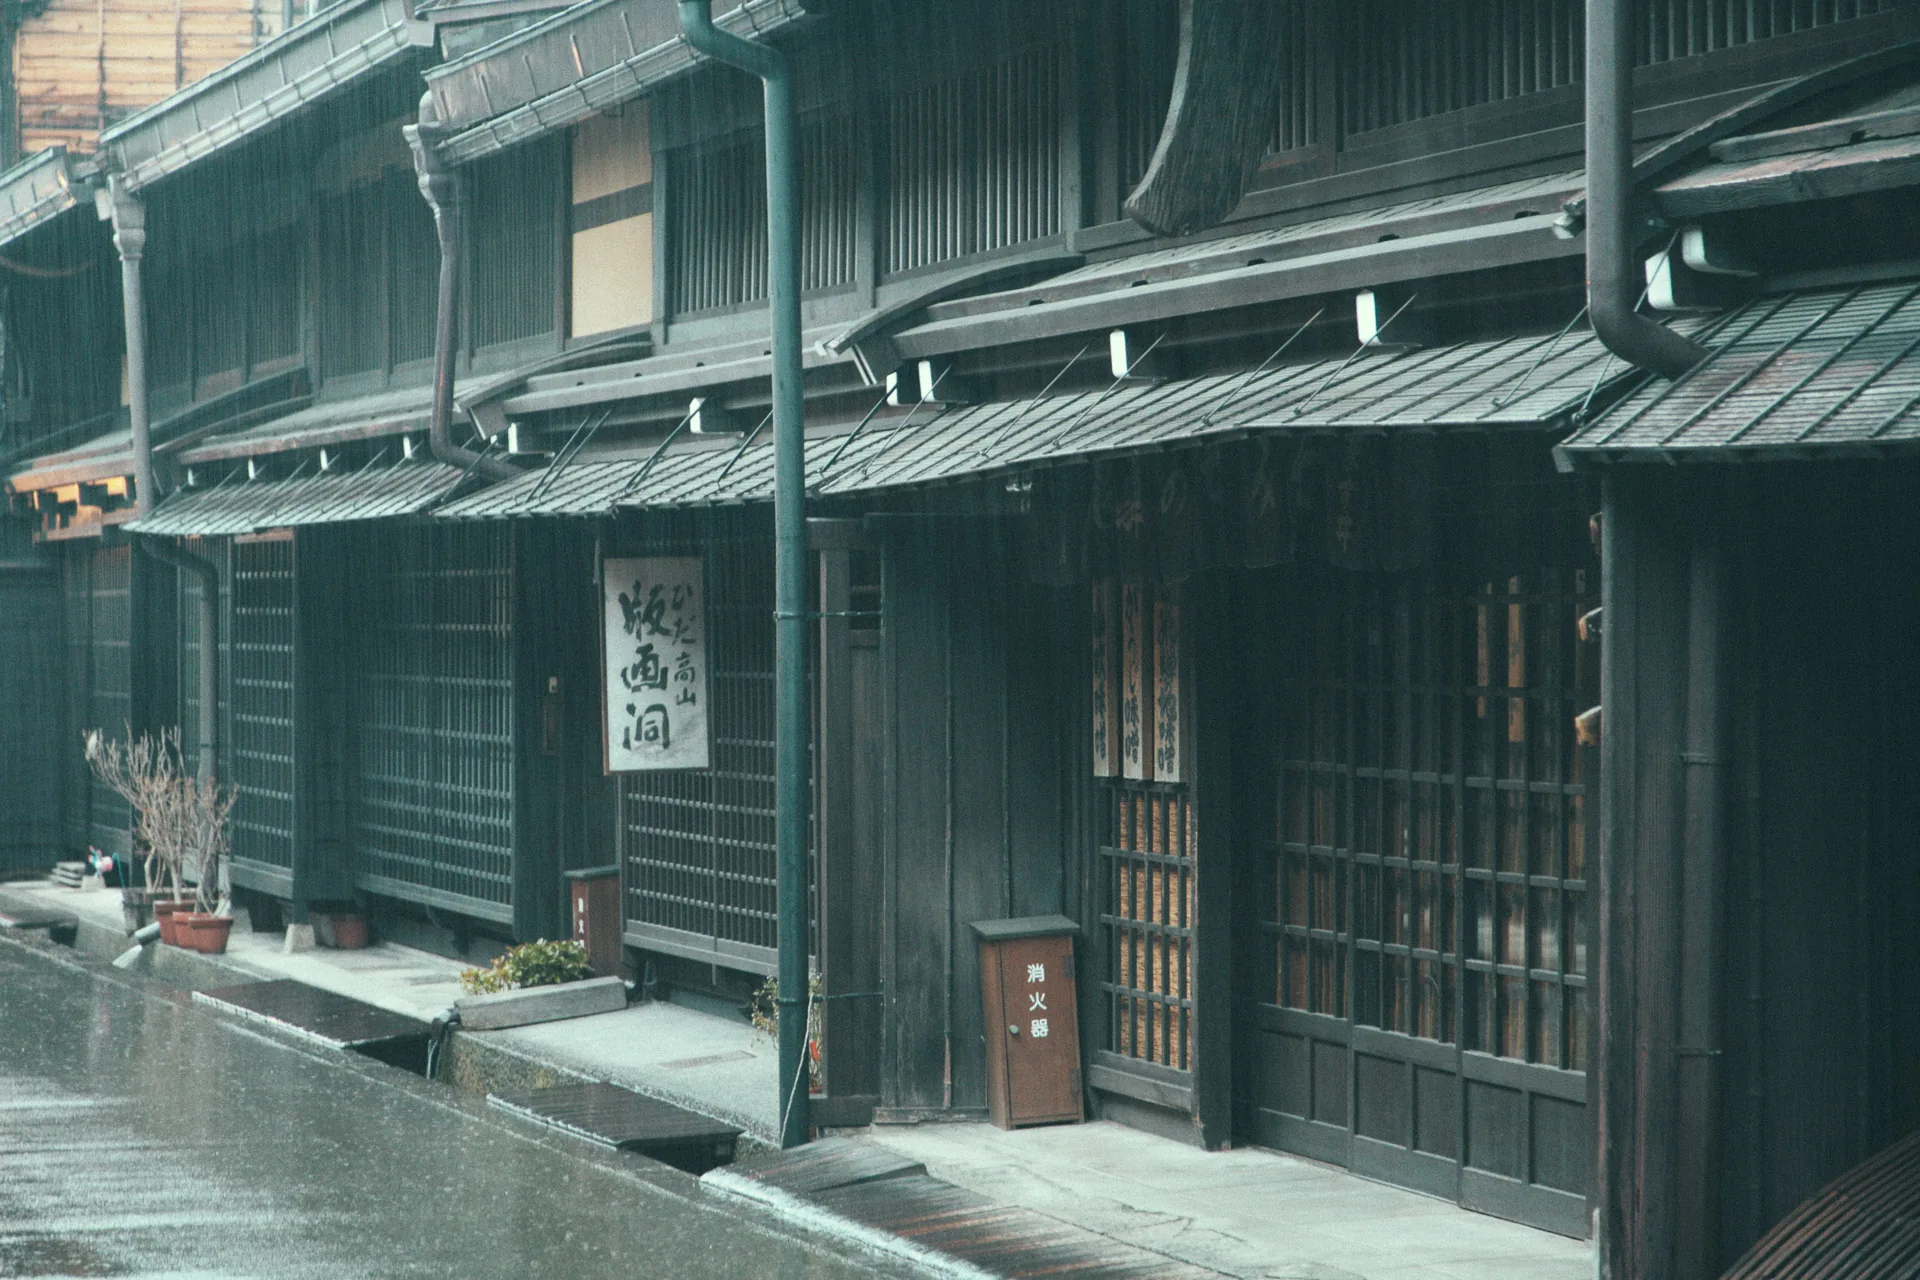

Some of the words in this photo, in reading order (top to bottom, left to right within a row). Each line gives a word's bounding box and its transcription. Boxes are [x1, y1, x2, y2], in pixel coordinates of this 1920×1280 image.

[619, 580, 672, 750] 版画洞
[673, 583, 697, 706] ひだ高山
[1027, 963, 1049, 1038] 消火器
